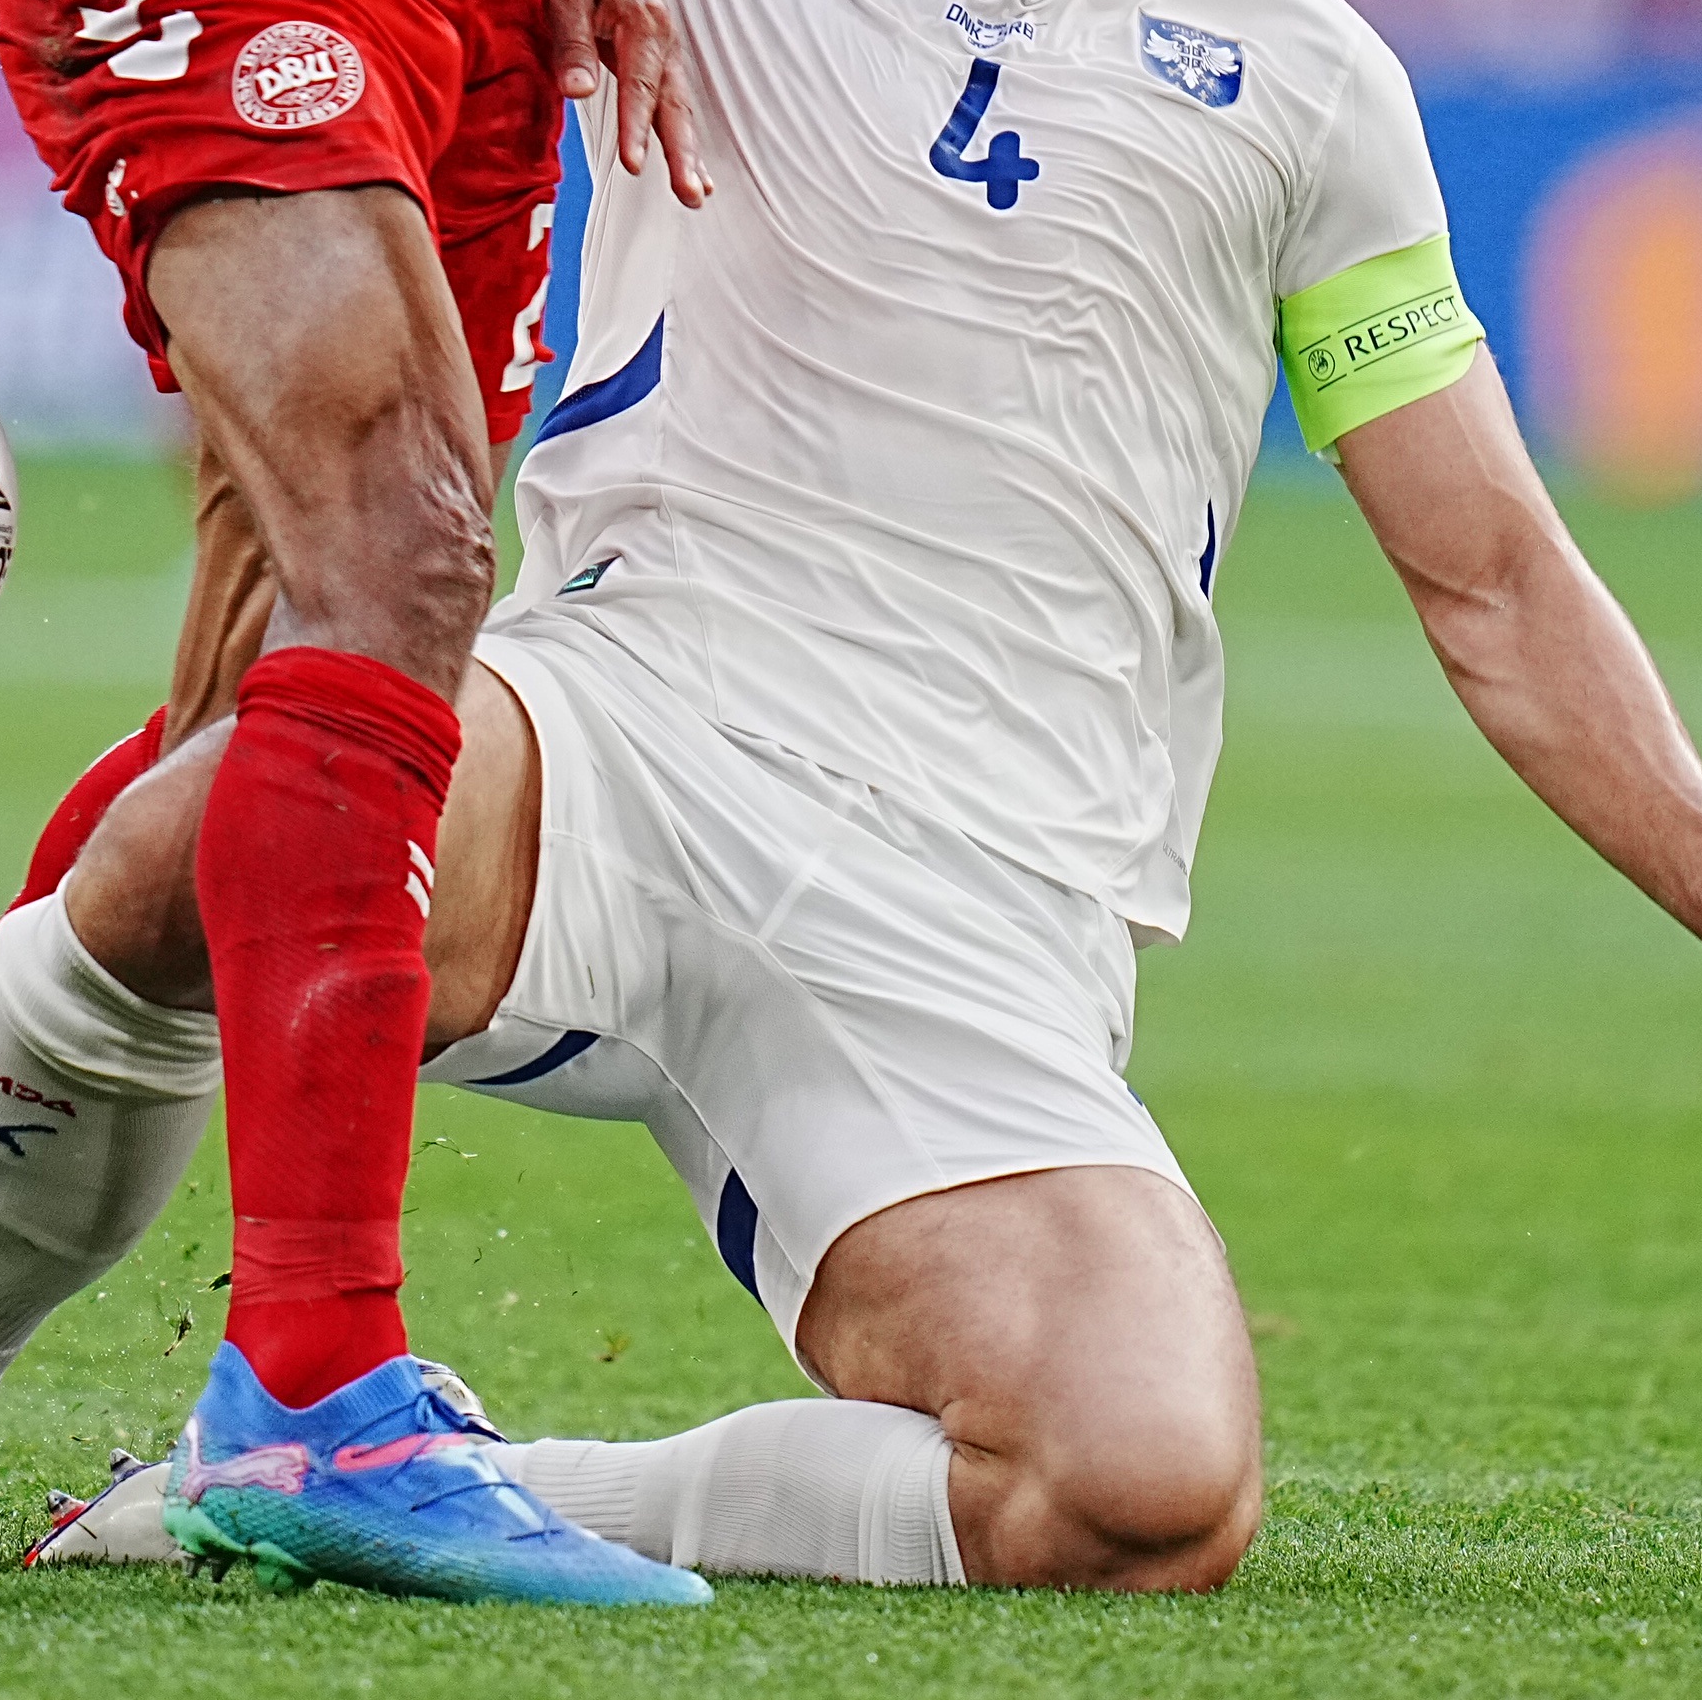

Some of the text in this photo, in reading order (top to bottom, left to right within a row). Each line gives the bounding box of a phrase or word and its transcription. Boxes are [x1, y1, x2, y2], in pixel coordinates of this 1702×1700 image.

[253, 51, 339, 101] DBU
[929, 58, 1040, 211] 4
[1343, 295, 1460, 362] RESPECT
